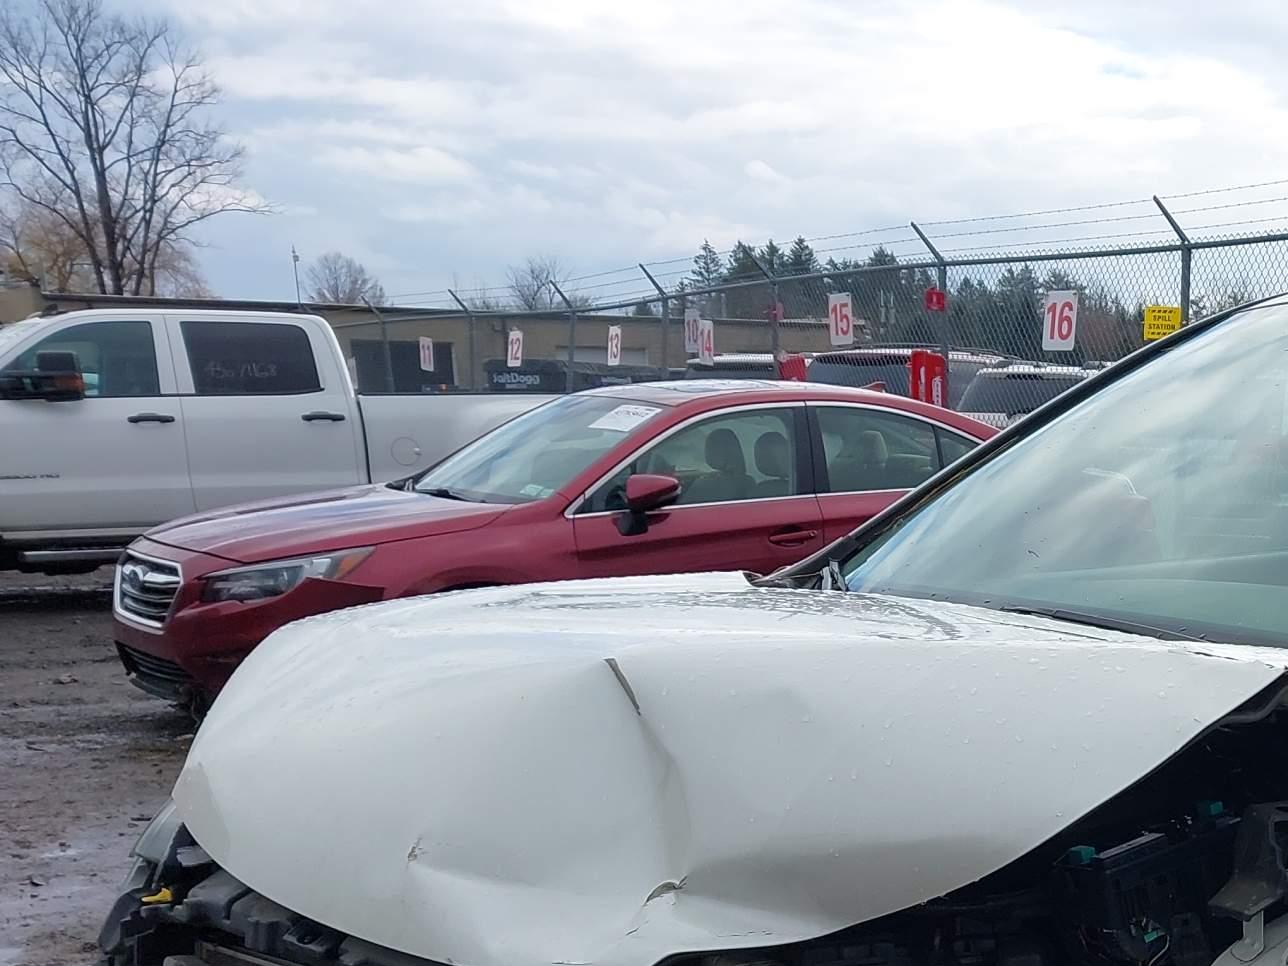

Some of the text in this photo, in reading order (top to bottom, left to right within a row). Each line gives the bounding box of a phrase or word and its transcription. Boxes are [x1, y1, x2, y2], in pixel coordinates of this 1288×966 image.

[831, 303, 850, 336] 15
[1047, 301, 1074, 341] 16
[421, 343, 432, 366] 11
[510, 337, 521, 361] 12
[609, 333, 620, 359] 13
[700, 328, 713, 357] 14
